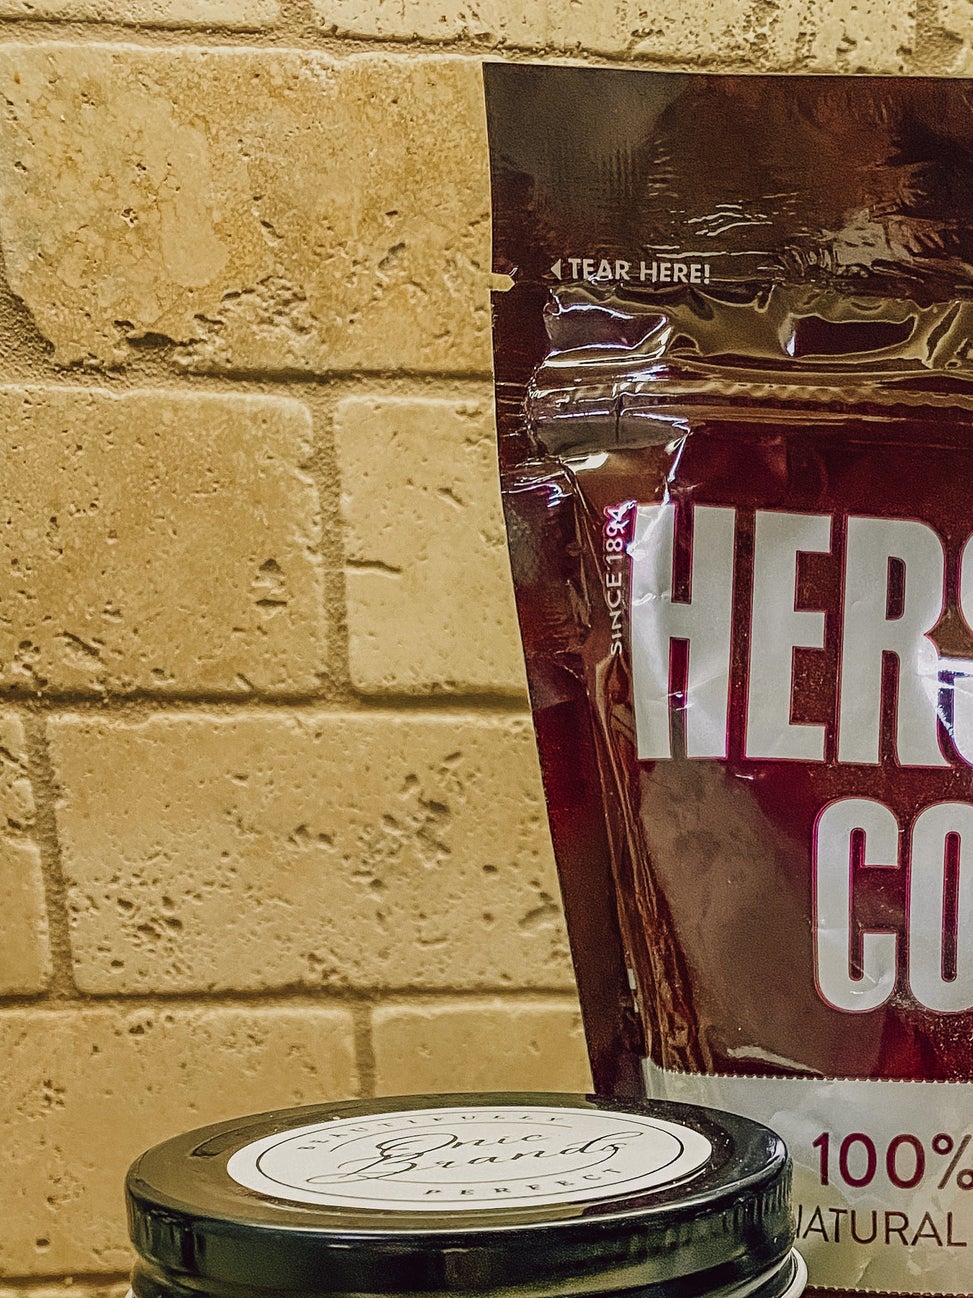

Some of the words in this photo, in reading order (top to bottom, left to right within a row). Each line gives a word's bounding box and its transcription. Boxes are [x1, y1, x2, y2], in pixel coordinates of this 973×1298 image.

[568, 258, 631, 281] TEAR
[640, 261, 710, 285] HERE!
[605, 501, 631, 565] 1894
[605, 572, 623, 655] SINCE
[306, 1131, 643, 1185] Brands
[424, 1168, 621, 1195] PERFECT
